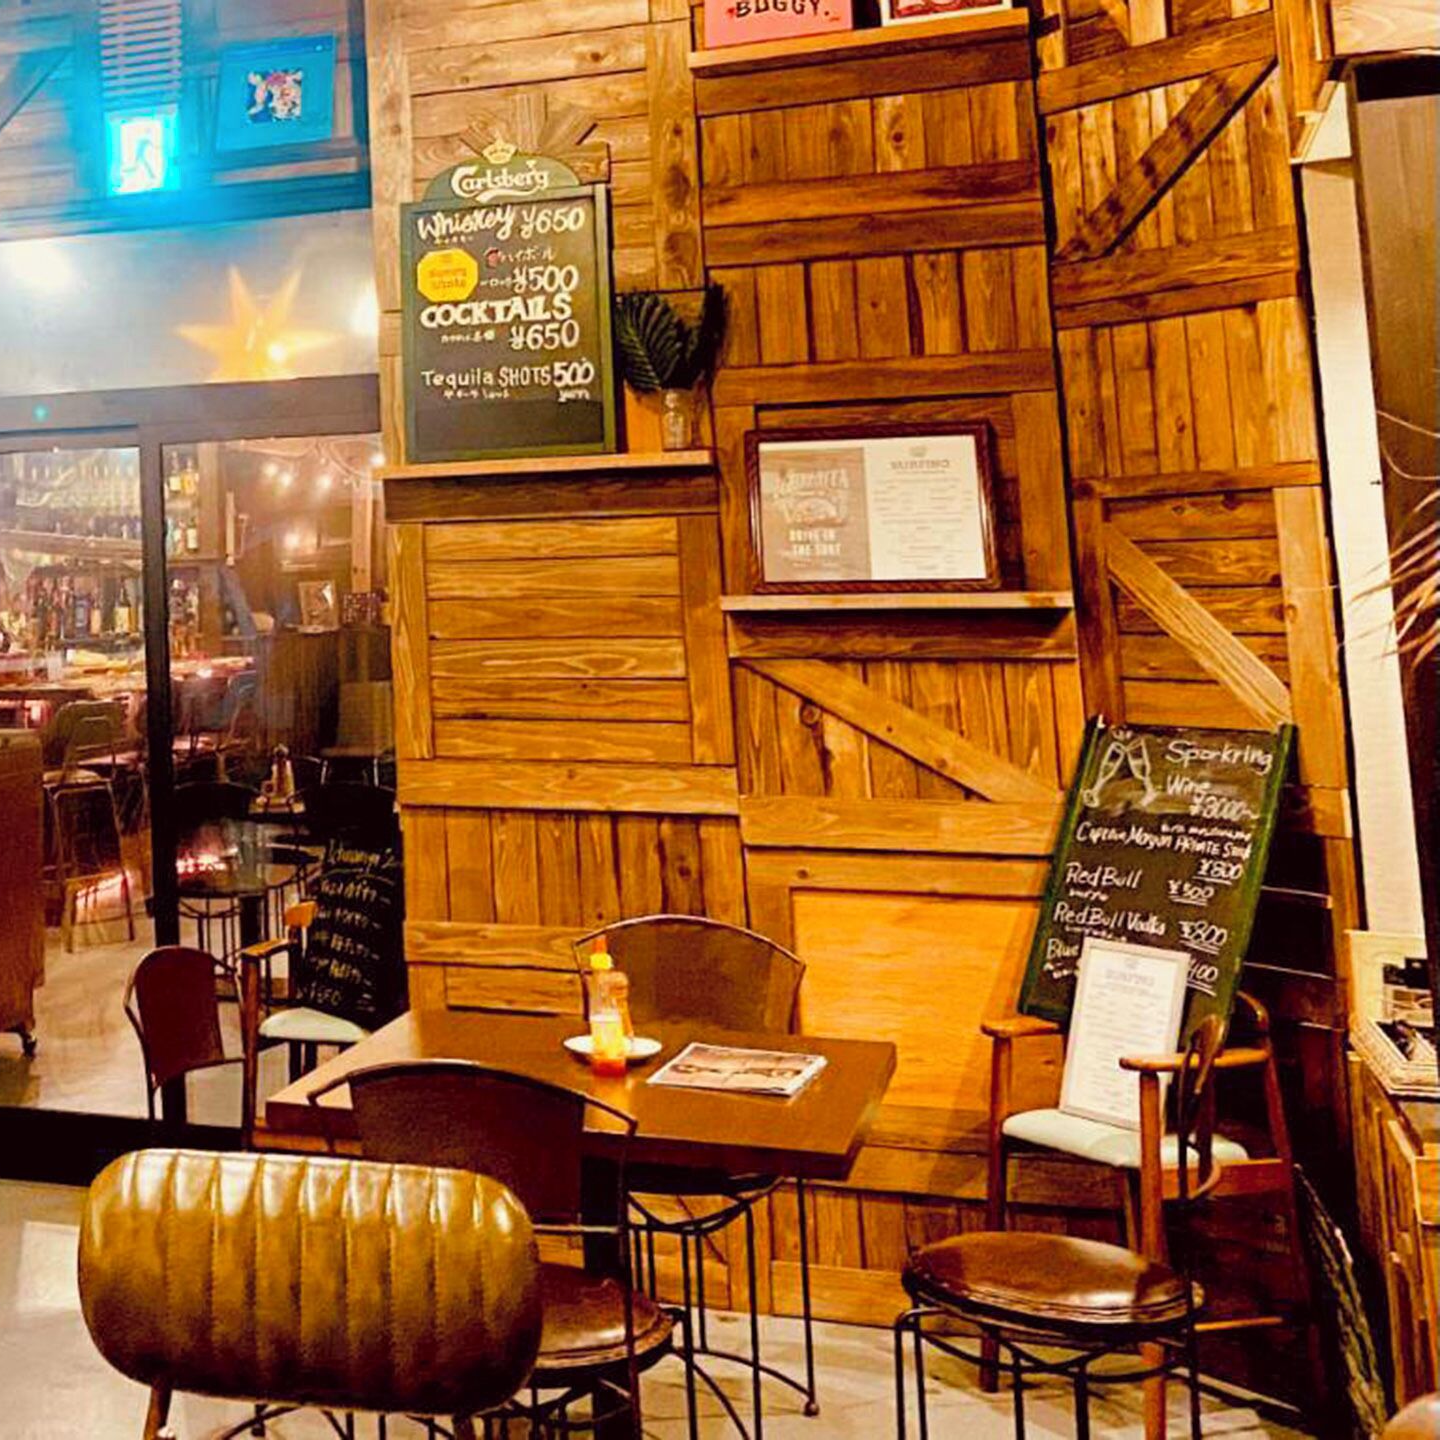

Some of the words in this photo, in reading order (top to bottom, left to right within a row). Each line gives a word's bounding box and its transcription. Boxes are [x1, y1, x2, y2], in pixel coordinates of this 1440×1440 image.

[451, 160, 549, 203] Carlsberg
[417, 204, 515, 241] Whiskey
[420, 292, 572, 328] COCKTAILS
[421, 368, 494, 389] Tequila
[498, 365, 551, 387] SHOTS
[553, 360, 595, 388] 500
[1166, 774, 1211, 796] Wine
